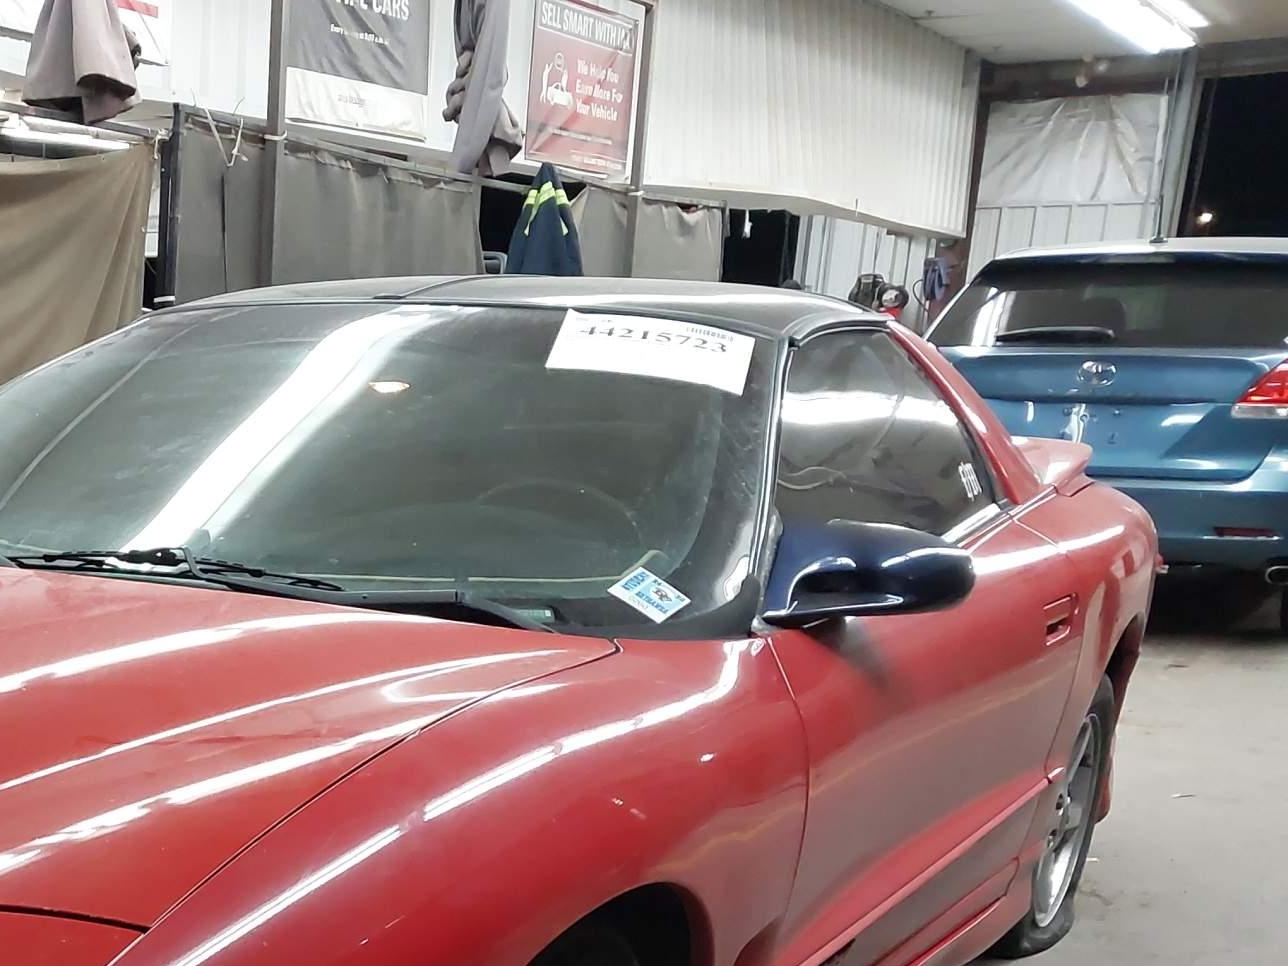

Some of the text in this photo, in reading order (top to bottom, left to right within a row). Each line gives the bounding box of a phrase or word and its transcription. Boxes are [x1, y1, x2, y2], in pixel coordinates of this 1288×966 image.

[372, 0, 410, 21] CARS
[330, 24, 343, 35] Every
[542, 1, 562, 28] SELL
[562, 8, 594, 39] SMART
[594, 18, 617, 48] WITH
[577, 59, 589, 75] We
[606, 67, 619, 83] You
[591, 102, 618, 121] Vehicle
[578, 326, 727, 353] 44215723
